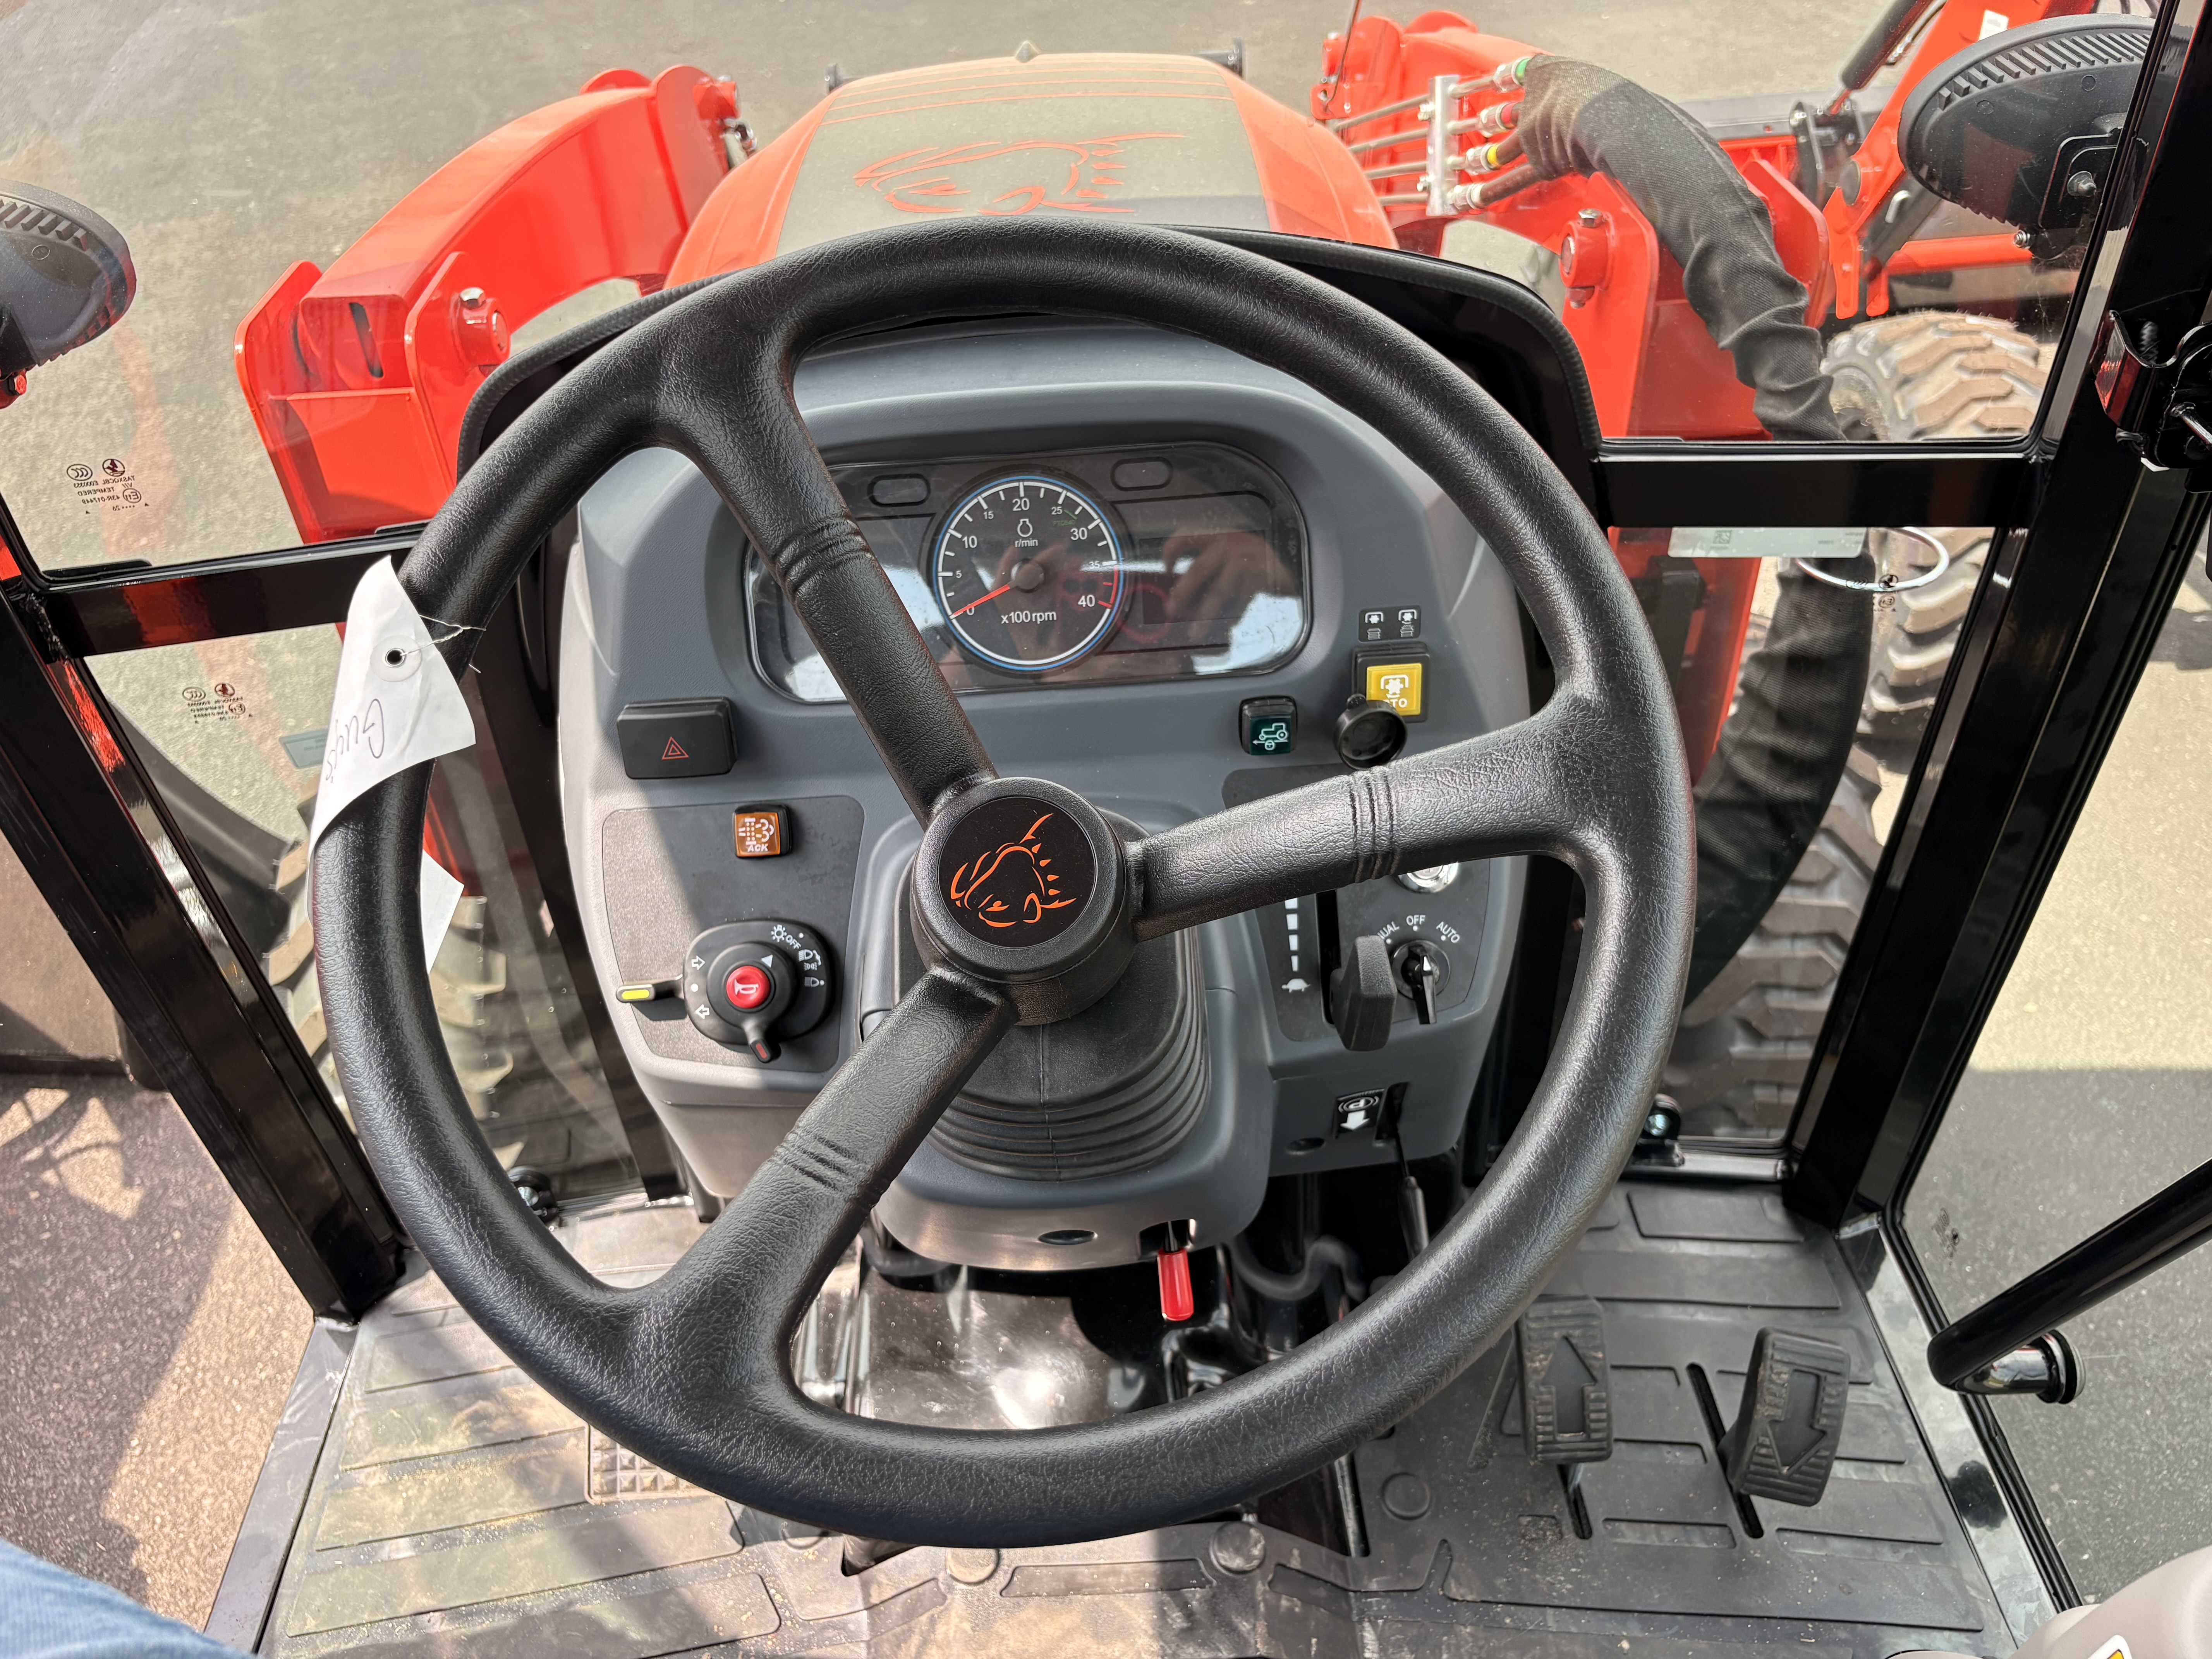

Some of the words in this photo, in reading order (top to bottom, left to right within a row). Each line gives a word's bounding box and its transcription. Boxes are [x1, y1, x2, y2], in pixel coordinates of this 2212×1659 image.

[1012, 498, 1030, 511] 20
[1051, 507, 1063, 515] 25
[1070, 528, 1087, 540] 30
[962, 536, 977, 548] 10
[1015, 538, 1038, 547] r/min
[1078, 595, 1096, 607] 40
[967, 606, 975, 615] 0
[747, 843, 768, 852] ACK
[1406, 914, 1426, 926] OFF
[1436, 921, 1460, 943] AUTO
[786, 934, 801, 949] OFF
